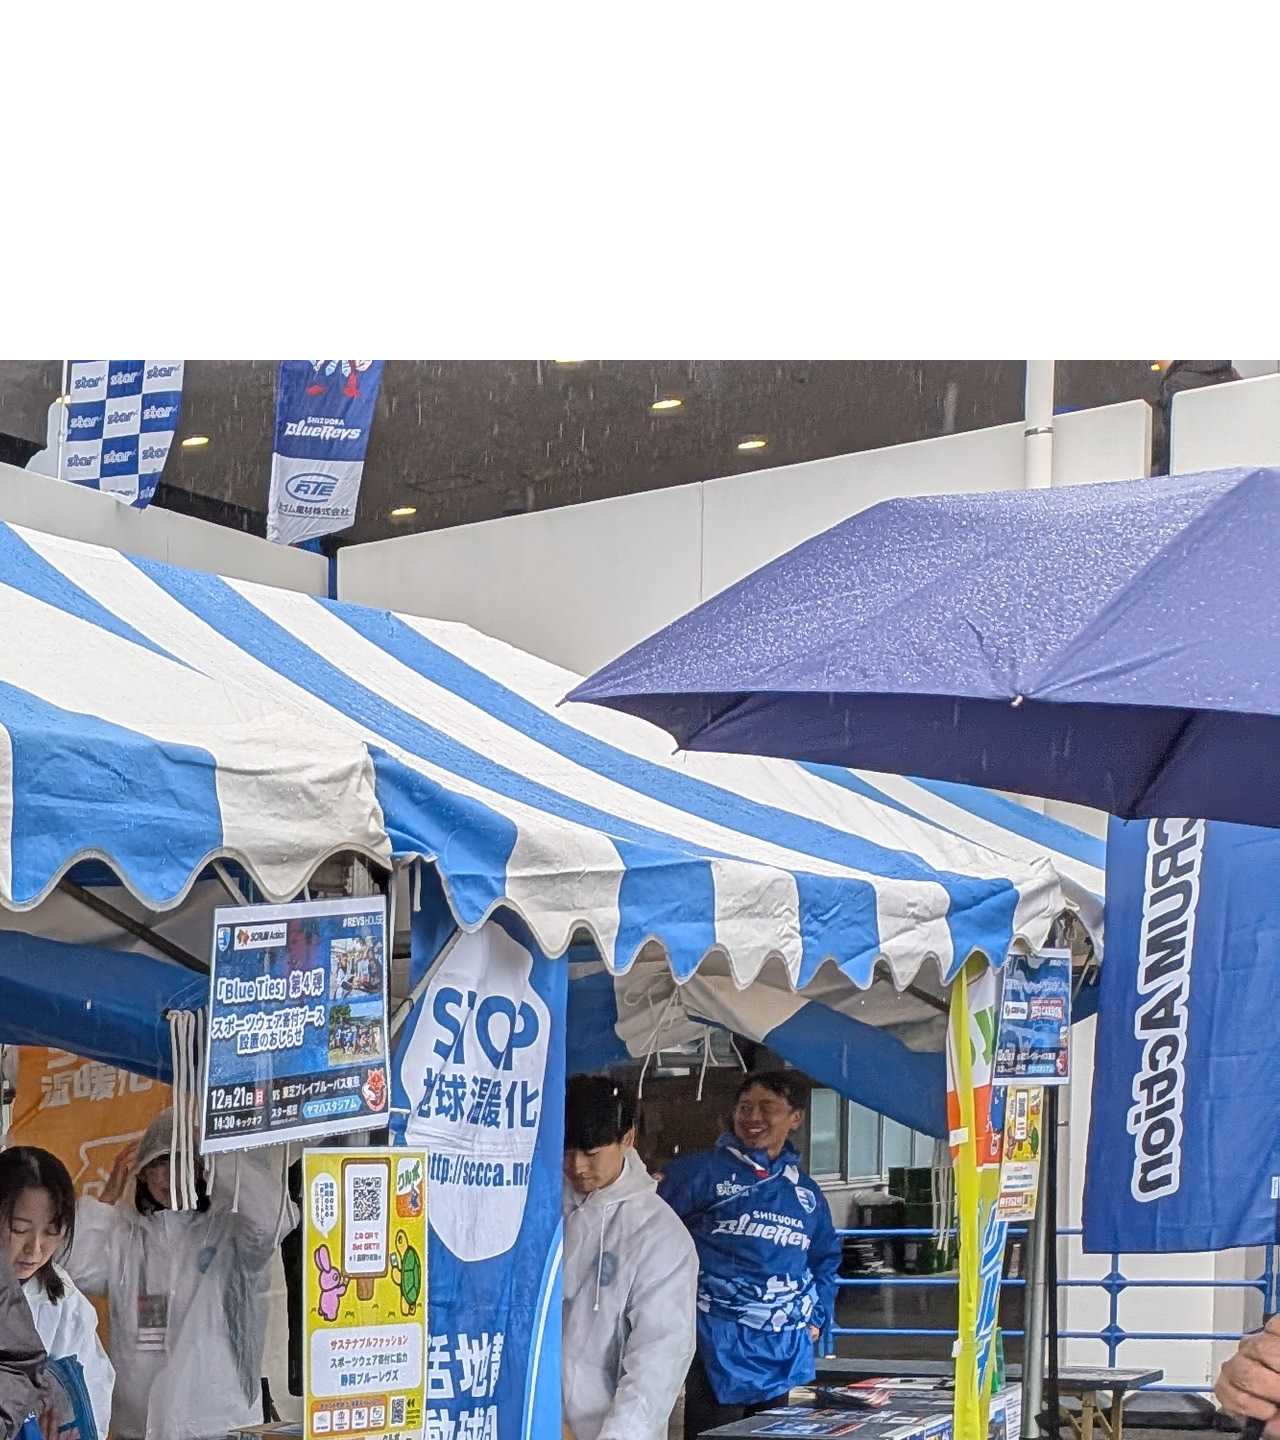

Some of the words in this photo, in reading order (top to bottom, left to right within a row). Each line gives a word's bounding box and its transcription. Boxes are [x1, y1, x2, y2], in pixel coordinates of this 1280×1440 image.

[250, 929, 269, 943] SCRUM
[289, 968, 325, 998] 第4弾
[1133, 986, 1186, 1194] Action
[213, 1115, 235, 1131] 14:30
[752, 1210, 805, 1229] SHIZUOKA
